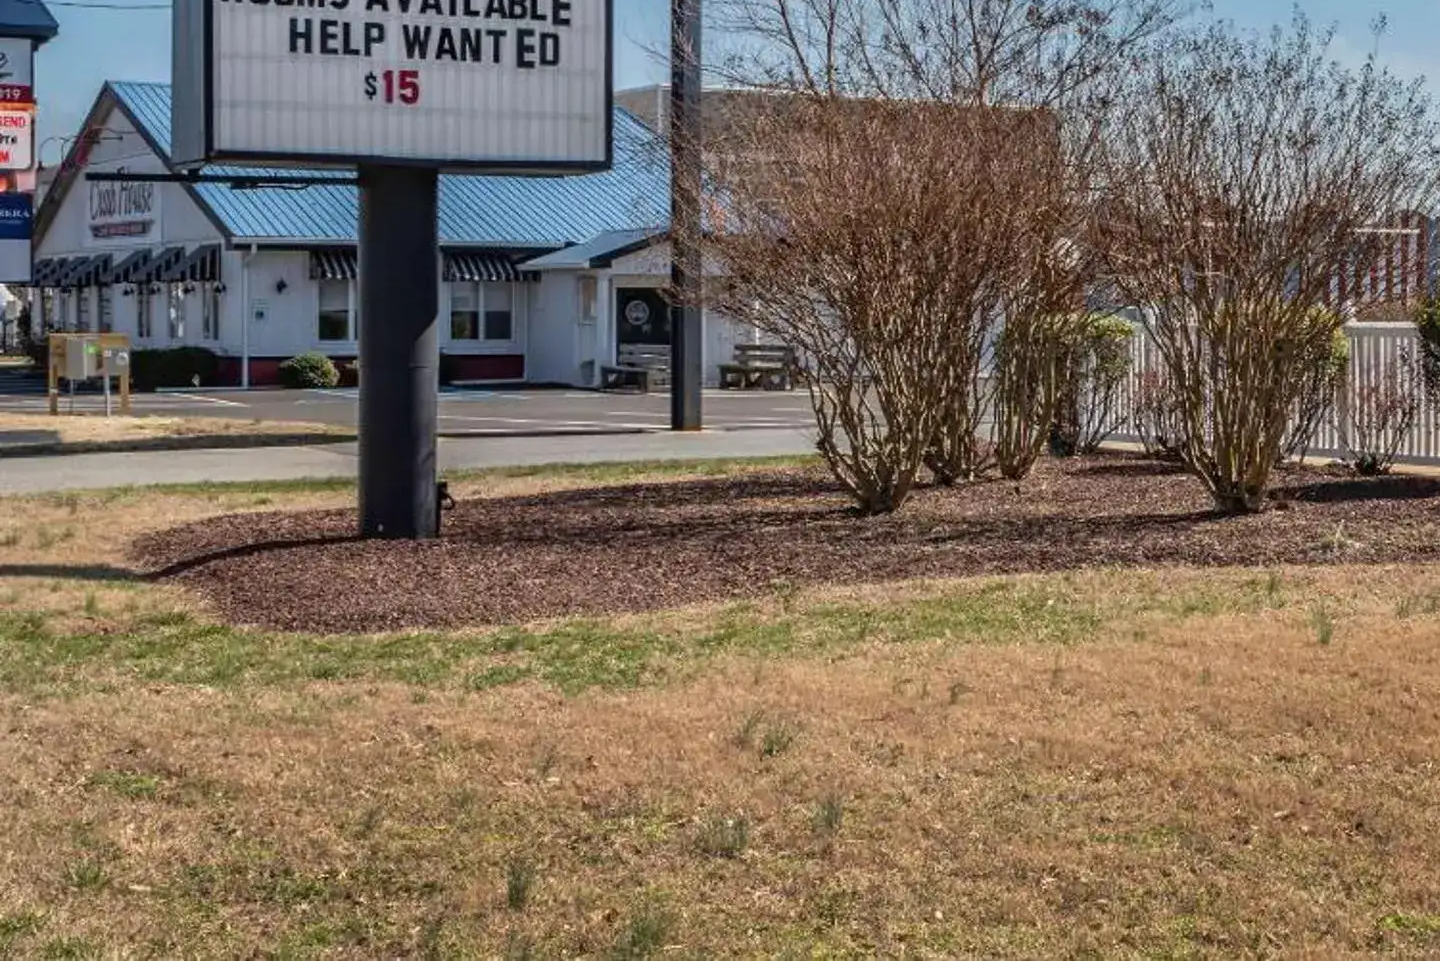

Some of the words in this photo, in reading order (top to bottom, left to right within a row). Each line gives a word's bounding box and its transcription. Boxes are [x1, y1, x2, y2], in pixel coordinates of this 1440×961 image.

[289, 17, 386, 57] HELP
[402, 24, 561, 70] WANTED
[364, 69, 420, 105] $15
